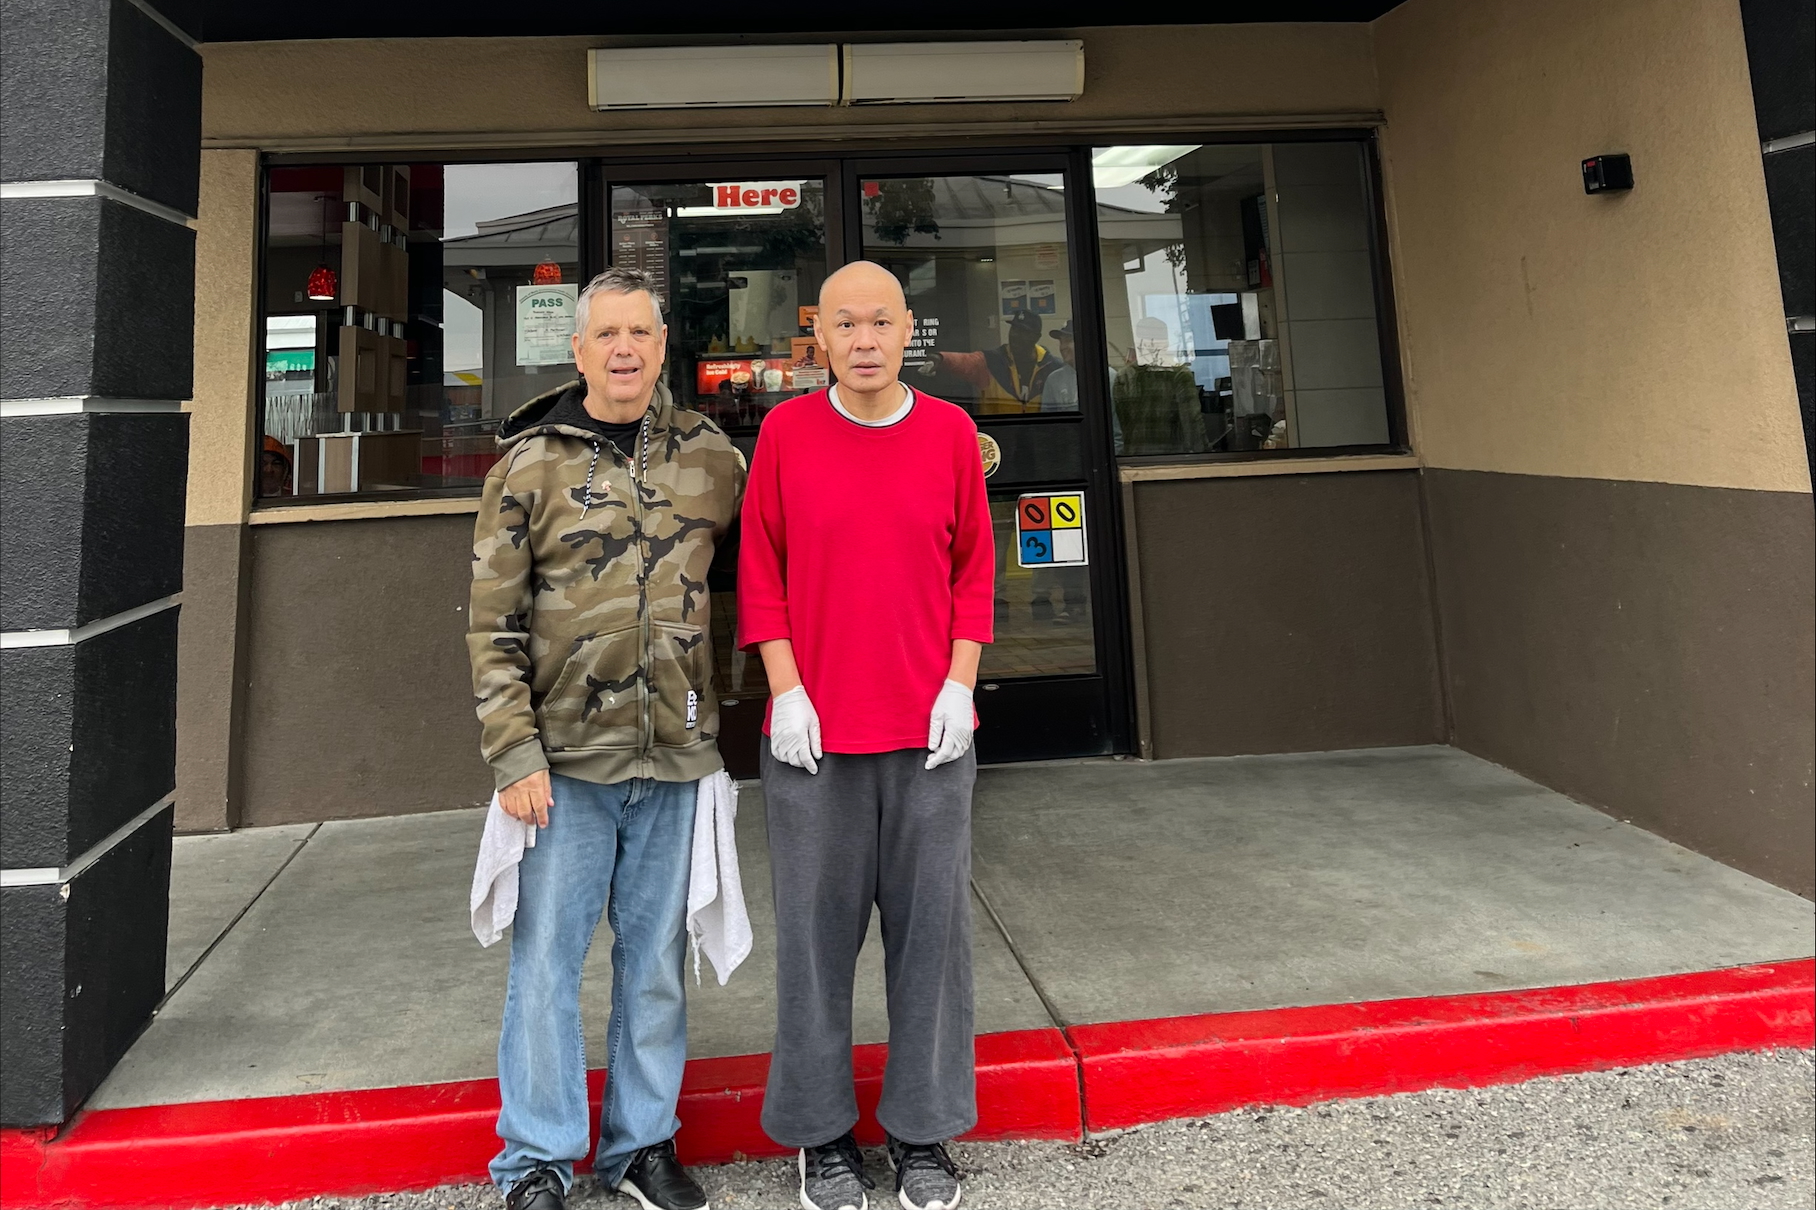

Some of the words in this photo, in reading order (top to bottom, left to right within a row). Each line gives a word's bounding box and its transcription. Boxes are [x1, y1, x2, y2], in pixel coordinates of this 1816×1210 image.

[717, 185, 797, 207] Here
[532, 298, 563, 307] PASS
[1025, 503, 1045, 524] 0
[1056, 501, 1076, 522] 0
[1026, 536, 1047, 557] 3
